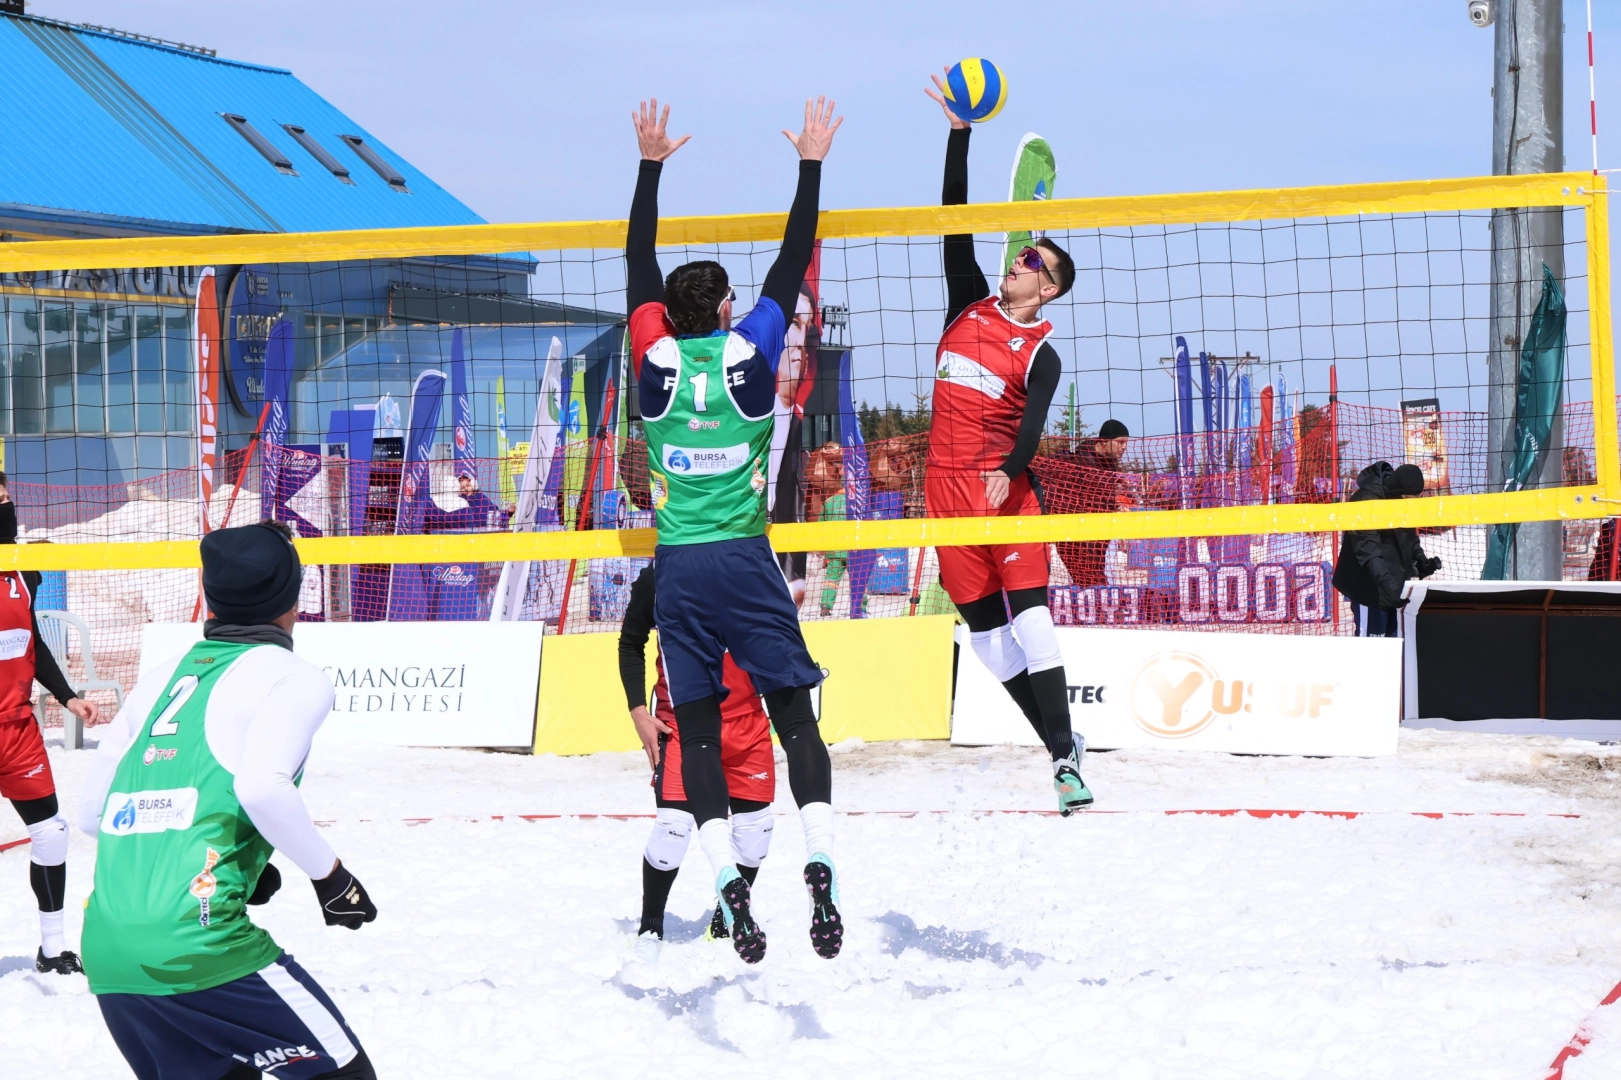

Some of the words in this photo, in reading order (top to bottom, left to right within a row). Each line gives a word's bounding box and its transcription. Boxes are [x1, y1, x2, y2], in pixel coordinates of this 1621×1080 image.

[689, 371, 708, 412] 1
[702, 421, 720, 430] TVF
[693, 453, 727, 461] BURSA
[5, 577, 21, 598] 2
[150, 675, 200, 737] 2
[156, 750, 177, 760] TVF
[138, 798, 172, 810] BURSA
